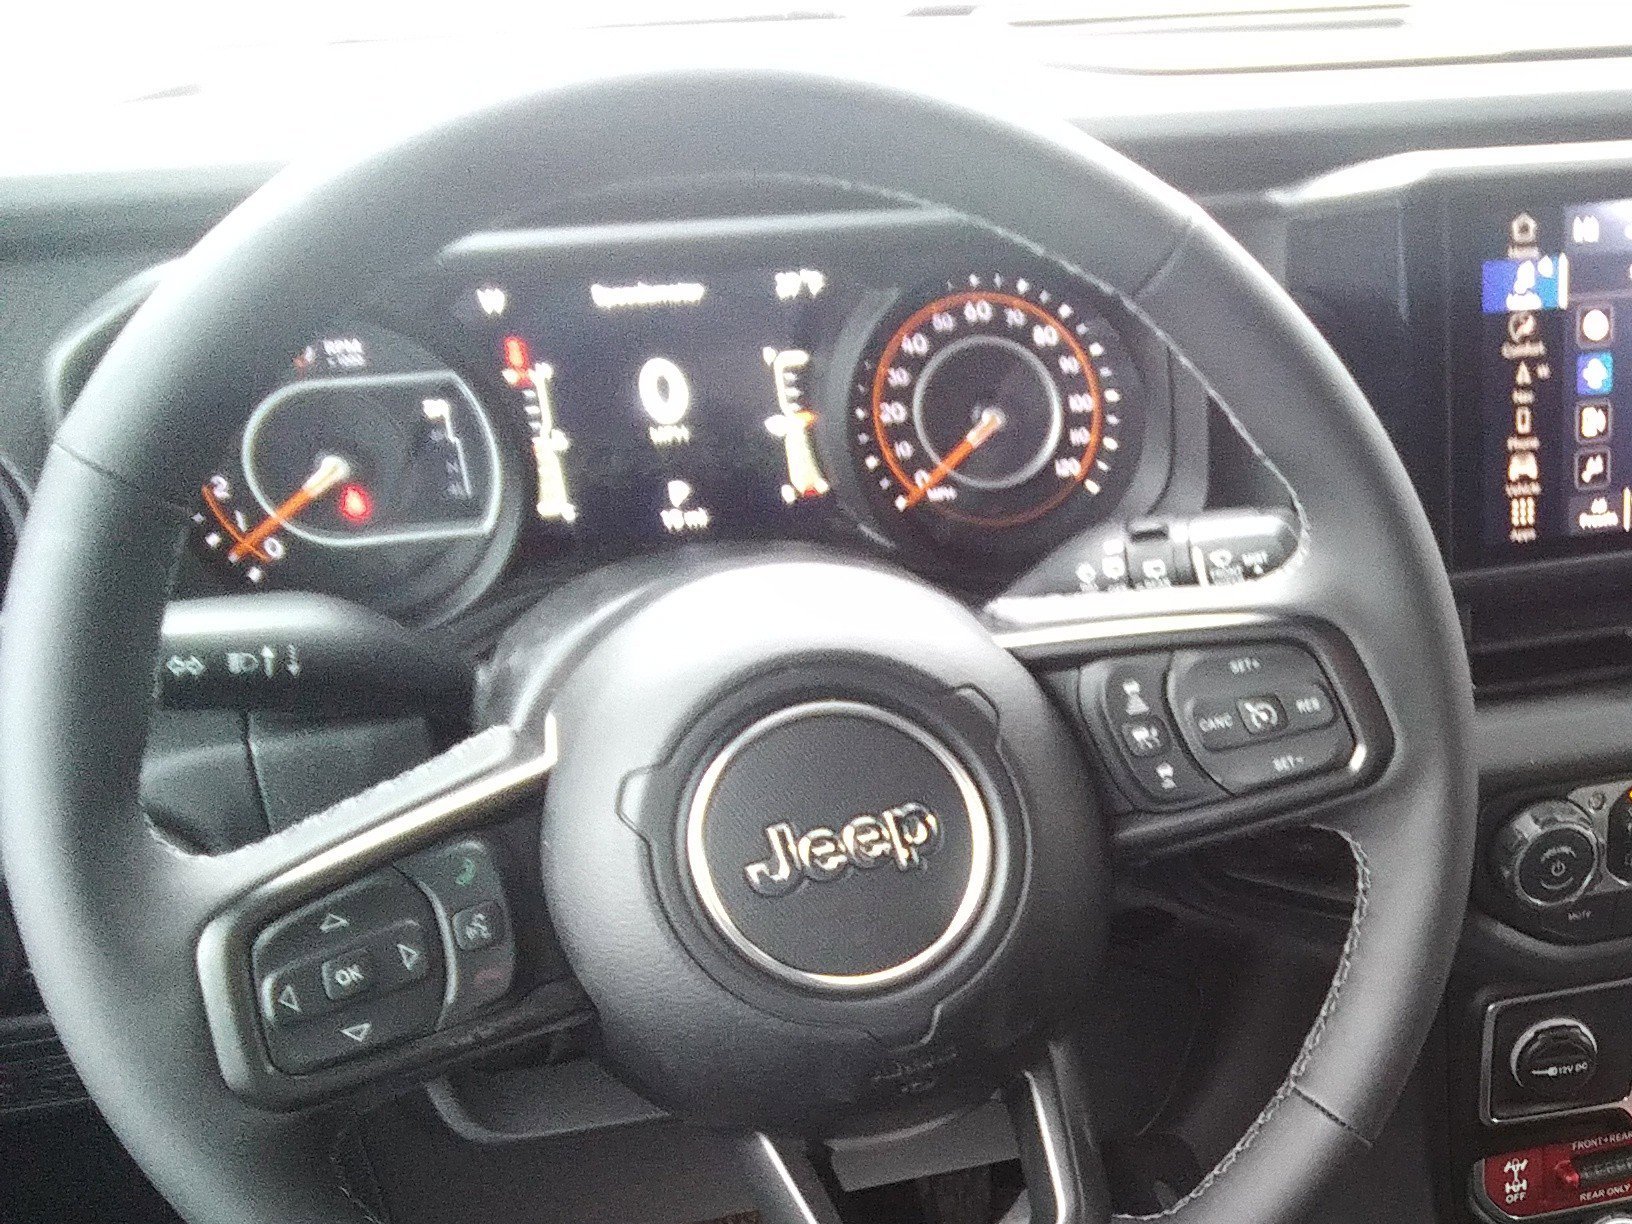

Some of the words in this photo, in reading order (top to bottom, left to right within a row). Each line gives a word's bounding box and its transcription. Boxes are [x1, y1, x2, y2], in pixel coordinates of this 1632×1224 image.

[638, 357, 690, 426] 0
[743, 801, 942, 893] Jeep
[334, 963, 365, 987] OK
[1505, 1191, 1528, 1205] OFF
[1579, 1189, 1606, 1203] REAR
[1606, 1183, 1632, 1199] ONLY
